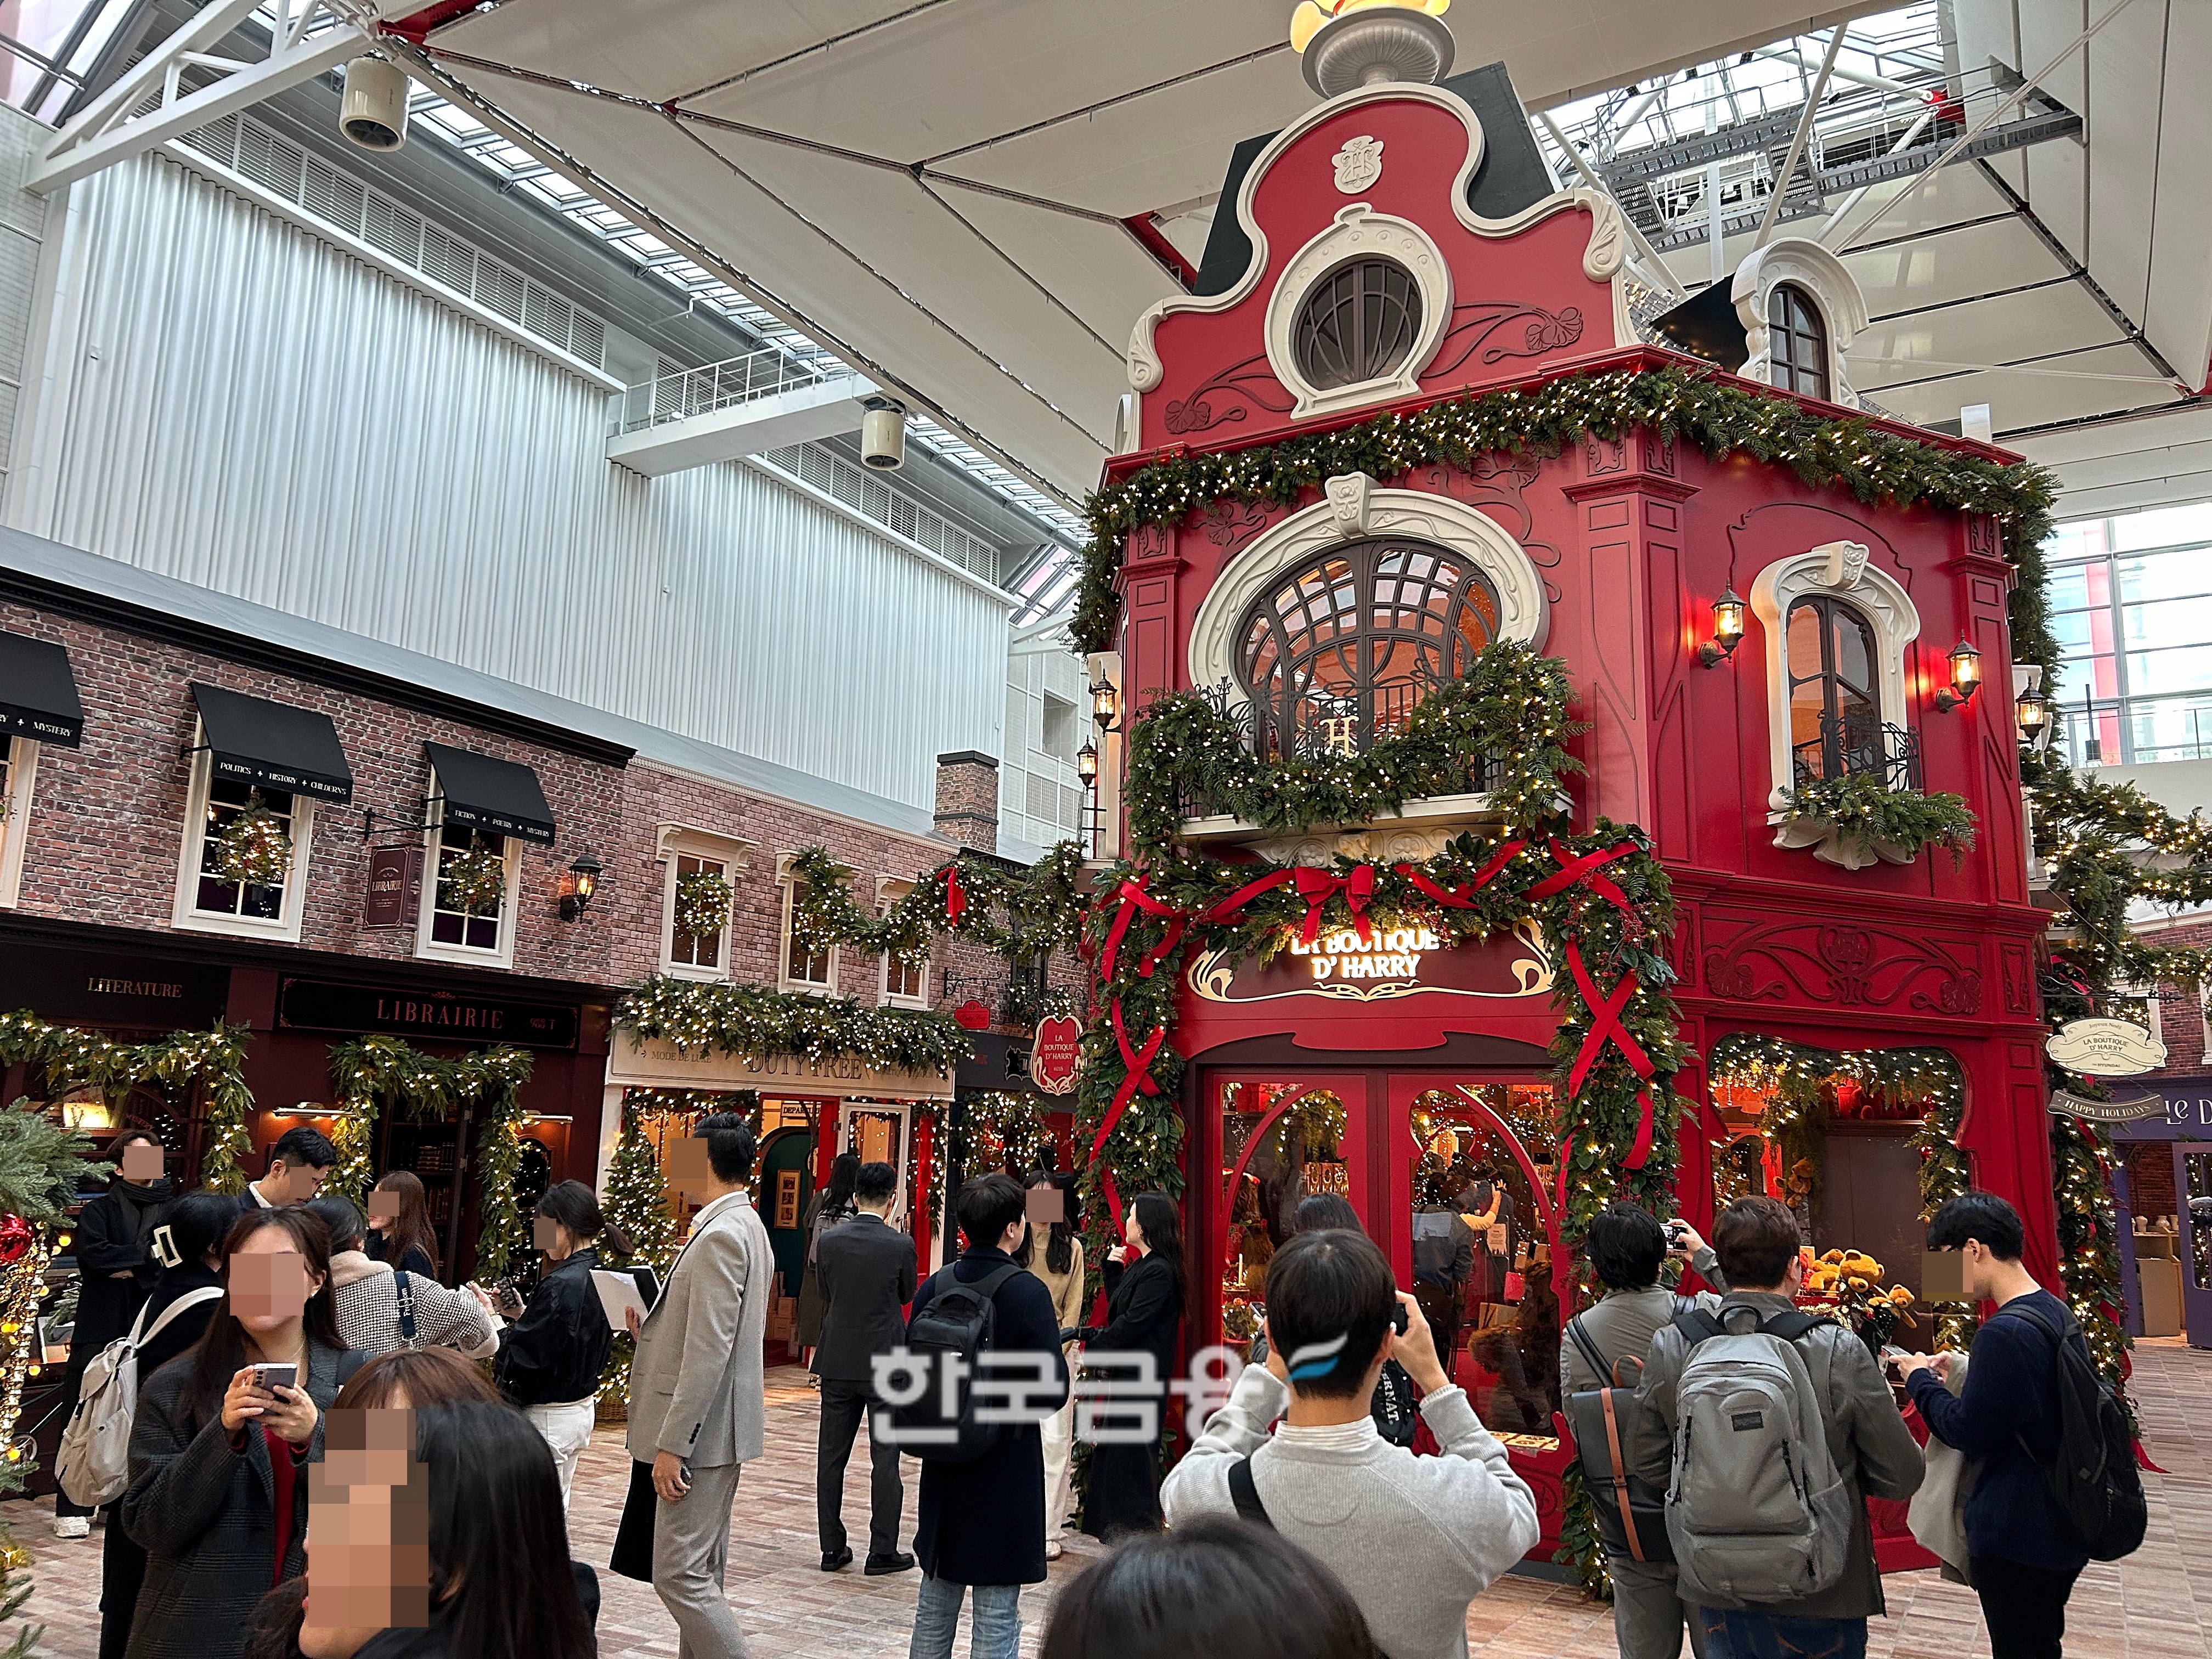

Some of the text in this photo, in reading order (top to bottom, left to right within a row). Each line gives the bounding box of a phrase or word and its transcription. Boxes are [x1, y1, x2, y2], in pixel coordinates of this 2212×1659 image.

[32, 721, 73, 737] MYSTERY
[220, 762, 251, 775] POLITICS
[269, 772, 297, 785] HISTORY
[455, 810, 476, 820] FICTION
[492, 819, 512, 828] POETRY
[372, 879, 402, 892] LIBRAIRIE
[87, 977, 182, 998] LITERATURE
[376, 999, 504, 1029] LIBRAIRIE
[1044, 1043, 1074, 1052] BOUTIQUE
[2093, 1037, 2129, 1047] BOUTIQUE
[651, 1051, 676, 1061] MODE
[748, 1052, 808, 1075] DUTY
[812, 1056, 862, 1079] FREE
[2064, 1099, 2151, 1117] HAPPY HOLIDAYS
